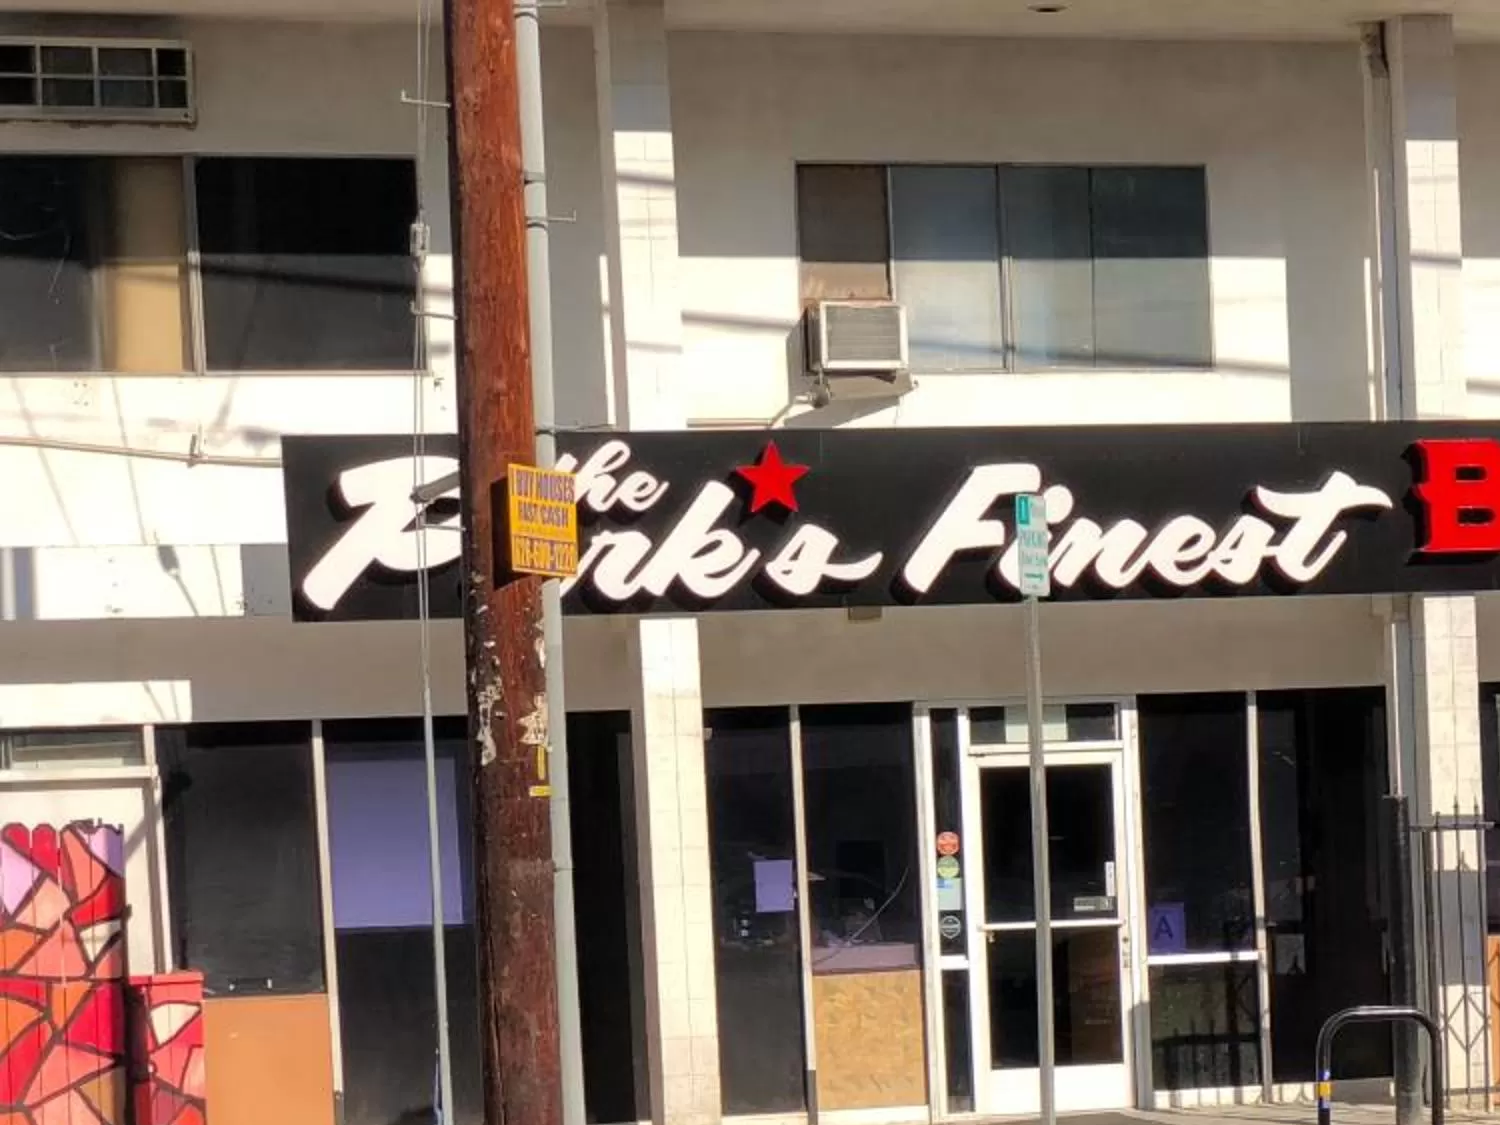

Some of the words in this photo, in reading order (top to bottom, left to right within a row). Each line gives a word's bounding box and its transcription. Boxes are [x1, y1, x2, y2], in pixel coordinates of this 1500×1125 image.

[538, 473, 576, 504] HOUSES
[541, 504, 569, 529] CASH
[1154, 915, 1174, 940] A
